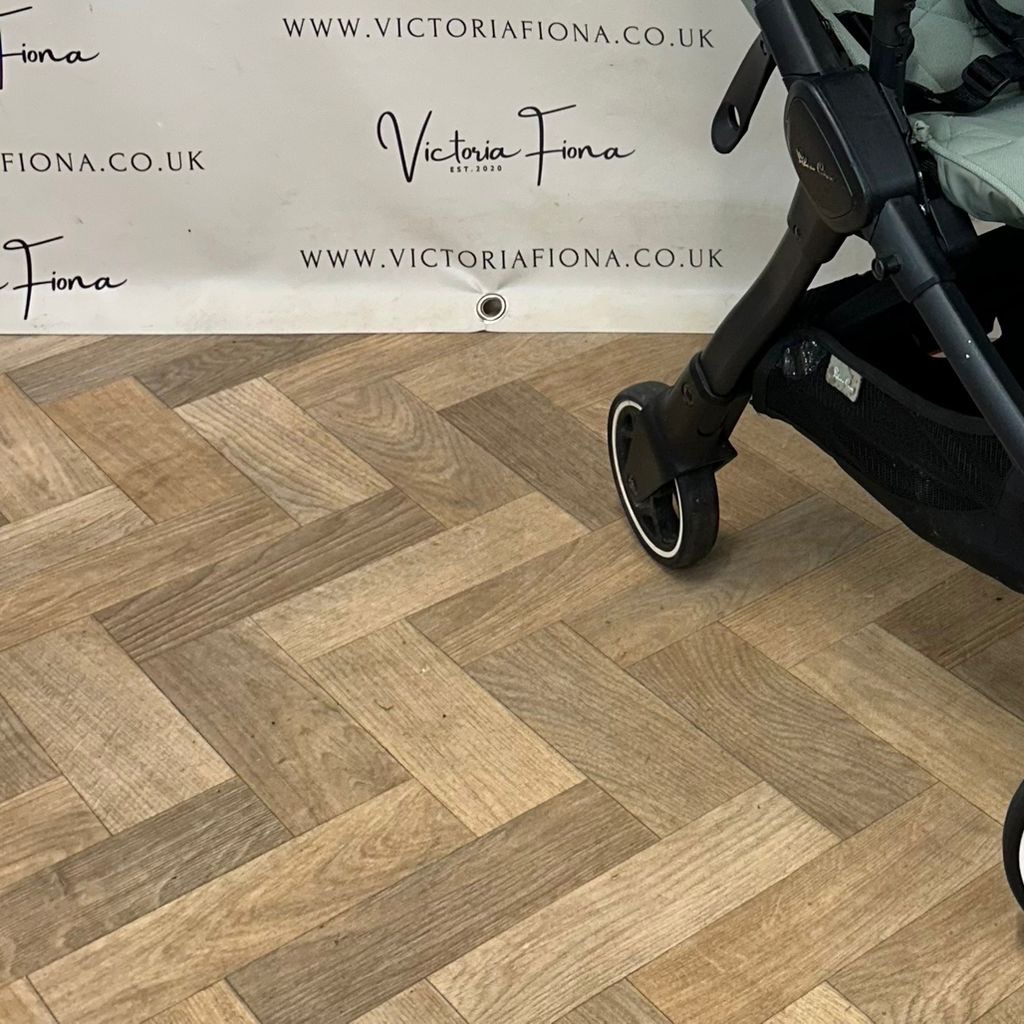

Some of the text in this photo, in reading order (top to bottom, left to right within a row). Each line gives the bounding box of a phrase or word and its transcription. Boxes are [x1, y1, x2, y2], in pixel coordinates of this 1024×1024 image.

[282, 18, 713, 48] WWW.VICTORIAFIONA.CO.UK
[377, 104, 635, 186] Victoria Fiona
[1, 151, 204, 172] FIONA.CO.UK
[450, 165, 502, 173] EST.2020
[300, 248, 723, 270] WWW.VICTORIAFIONA.CO.UK
[3, 236, 127, 320] Fiona
